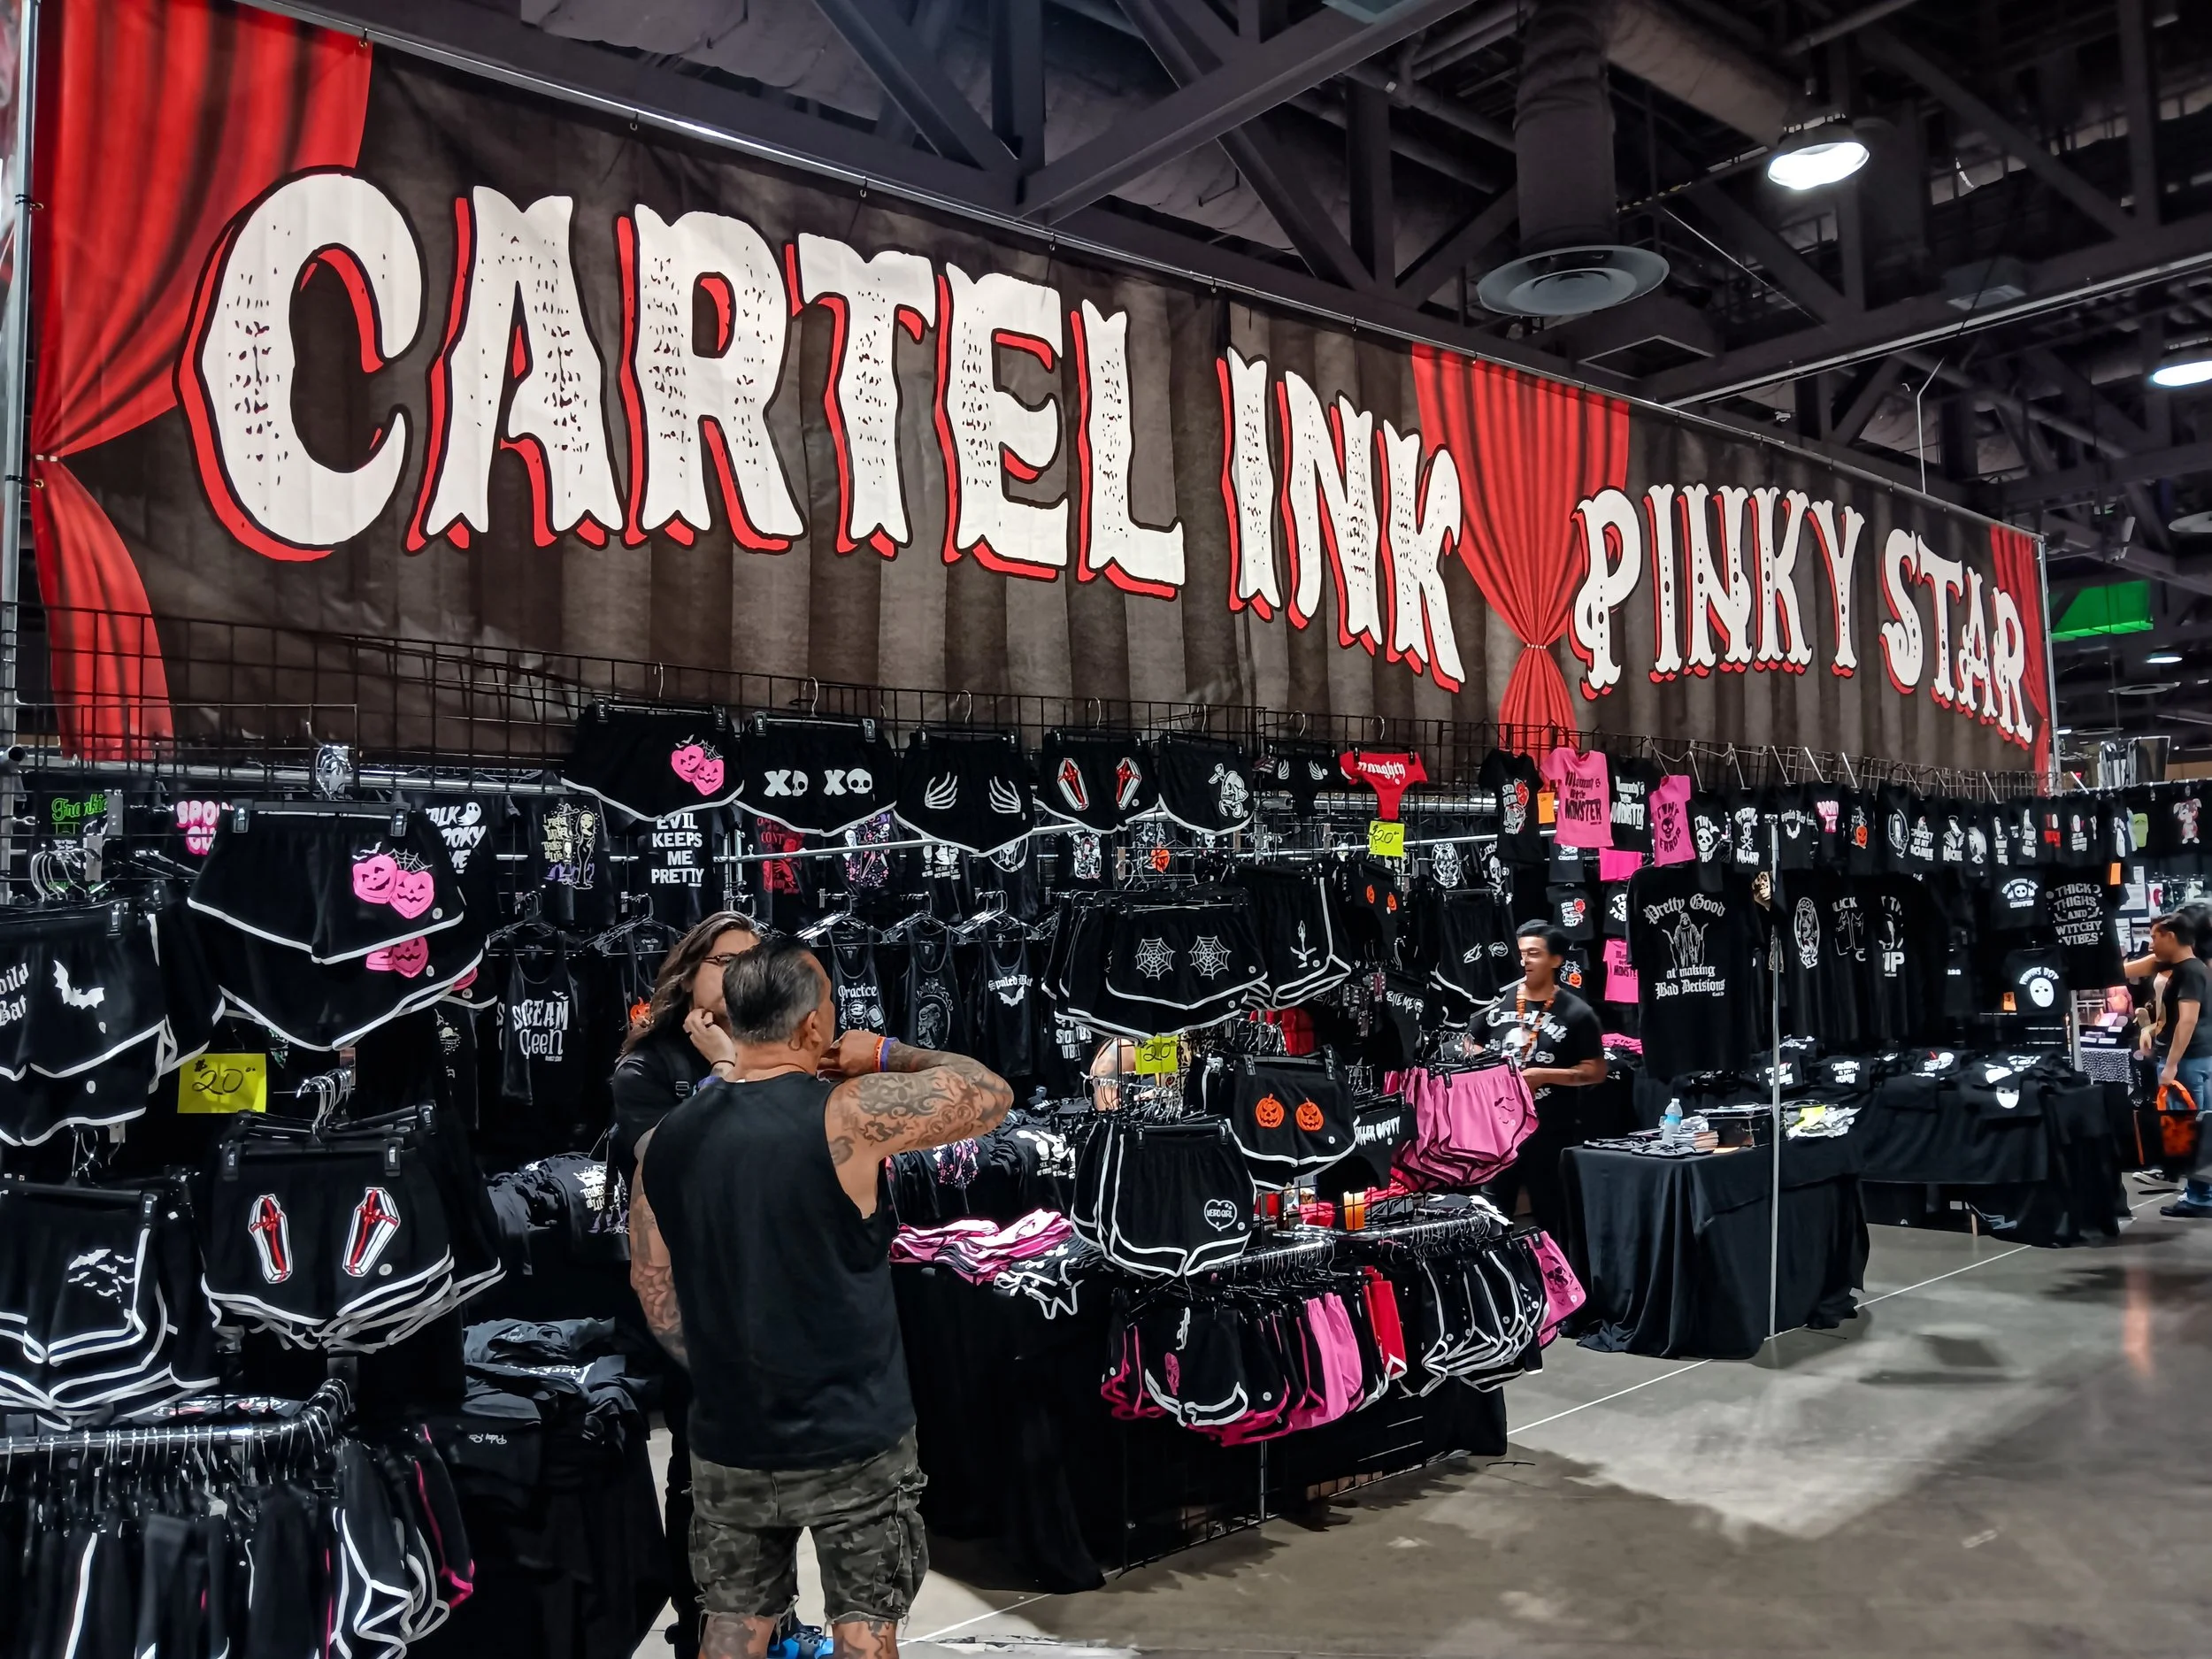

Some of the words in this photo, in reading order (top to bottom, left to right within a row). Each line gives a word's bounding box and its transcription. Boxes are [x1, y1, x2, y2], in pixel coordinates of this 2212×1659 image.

[179, 169, 1186, 602] CARTEL
[1216, 346, 1465, 693] INK
[1570, 483, 1865, 699] PINKY
[1879, 528, 2032, 750] STAR
[1357, 760, 1406, 780] naughty
[1564, 798, 1602, 822] MONSTER
[657, 812, 699, 830] EVIL
[652, 832, 703, 849] KEEPS
[667, 850, 694, 866] ME
[650, 867, 705, 885] PRETTY
[2055, 883, 2093, 898] THICK
[1643, 896, 1686, 925] Pretty
[1689, 893, 1726, 917] Good
[2054, 895, 2097, 911] THIGHS
[2067, 909, 2088, 920] AND
[2055, 920, 2103, 936] WITCHY
[2062, 933, 2099, 946] VIBES
[1666, 967, 1677, 979] at
[1678, 964, 1716, 978] making
[2043, 967, 2060, 980] BOY
[837, 984, 878, 999] Practice
[1655, 981, 1679, 1000] Bad
[1681, 979, 1726, 995] Decisions
[1386, 990, 1405, 1007] BITE
[1402, 995, 1415, 1014] ME
[1356, 1125, 1377, 1146] ILLER
